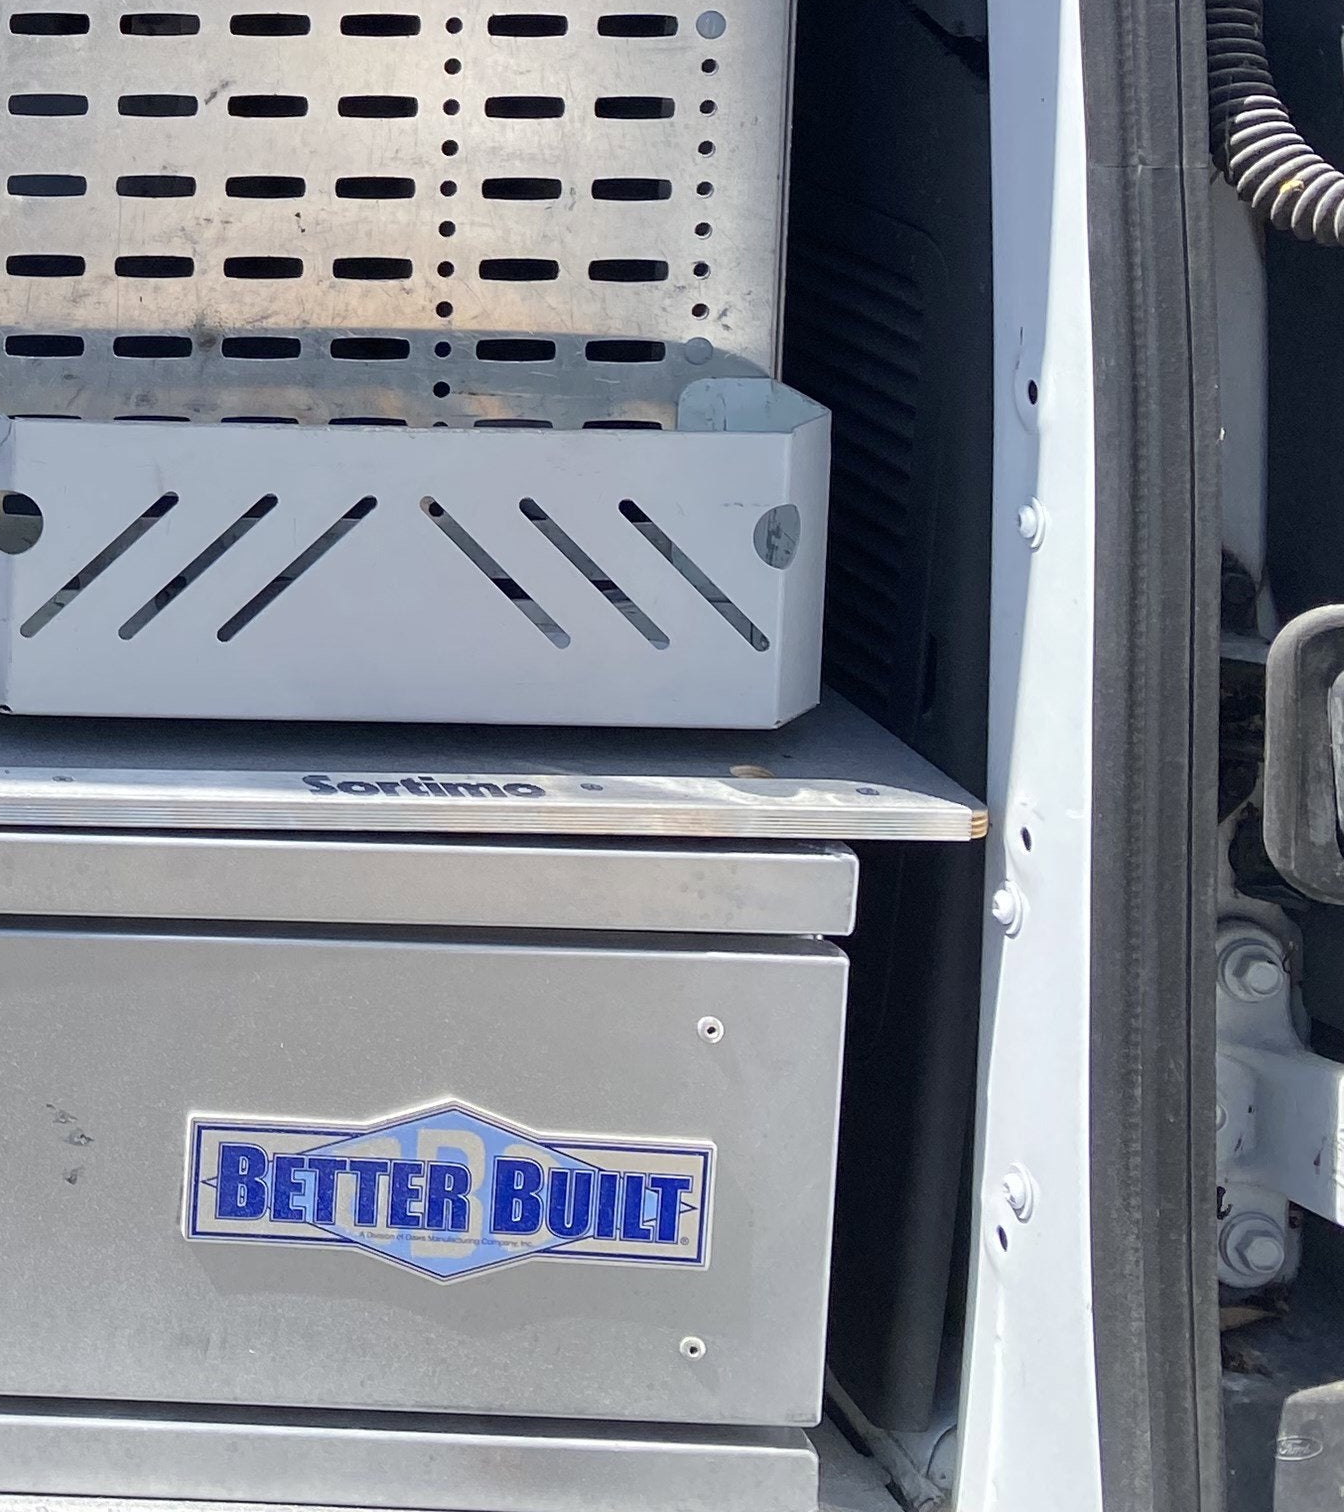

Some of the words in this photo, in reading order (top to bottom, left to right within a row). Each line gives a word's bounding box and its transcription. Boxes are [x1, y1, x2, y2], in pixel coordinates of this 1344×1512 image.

[302, 774, 546, 798] Sortimo
[215, 1141, 472, 1232] BETTER
[490, 1155, 694, 1245] BUILT
